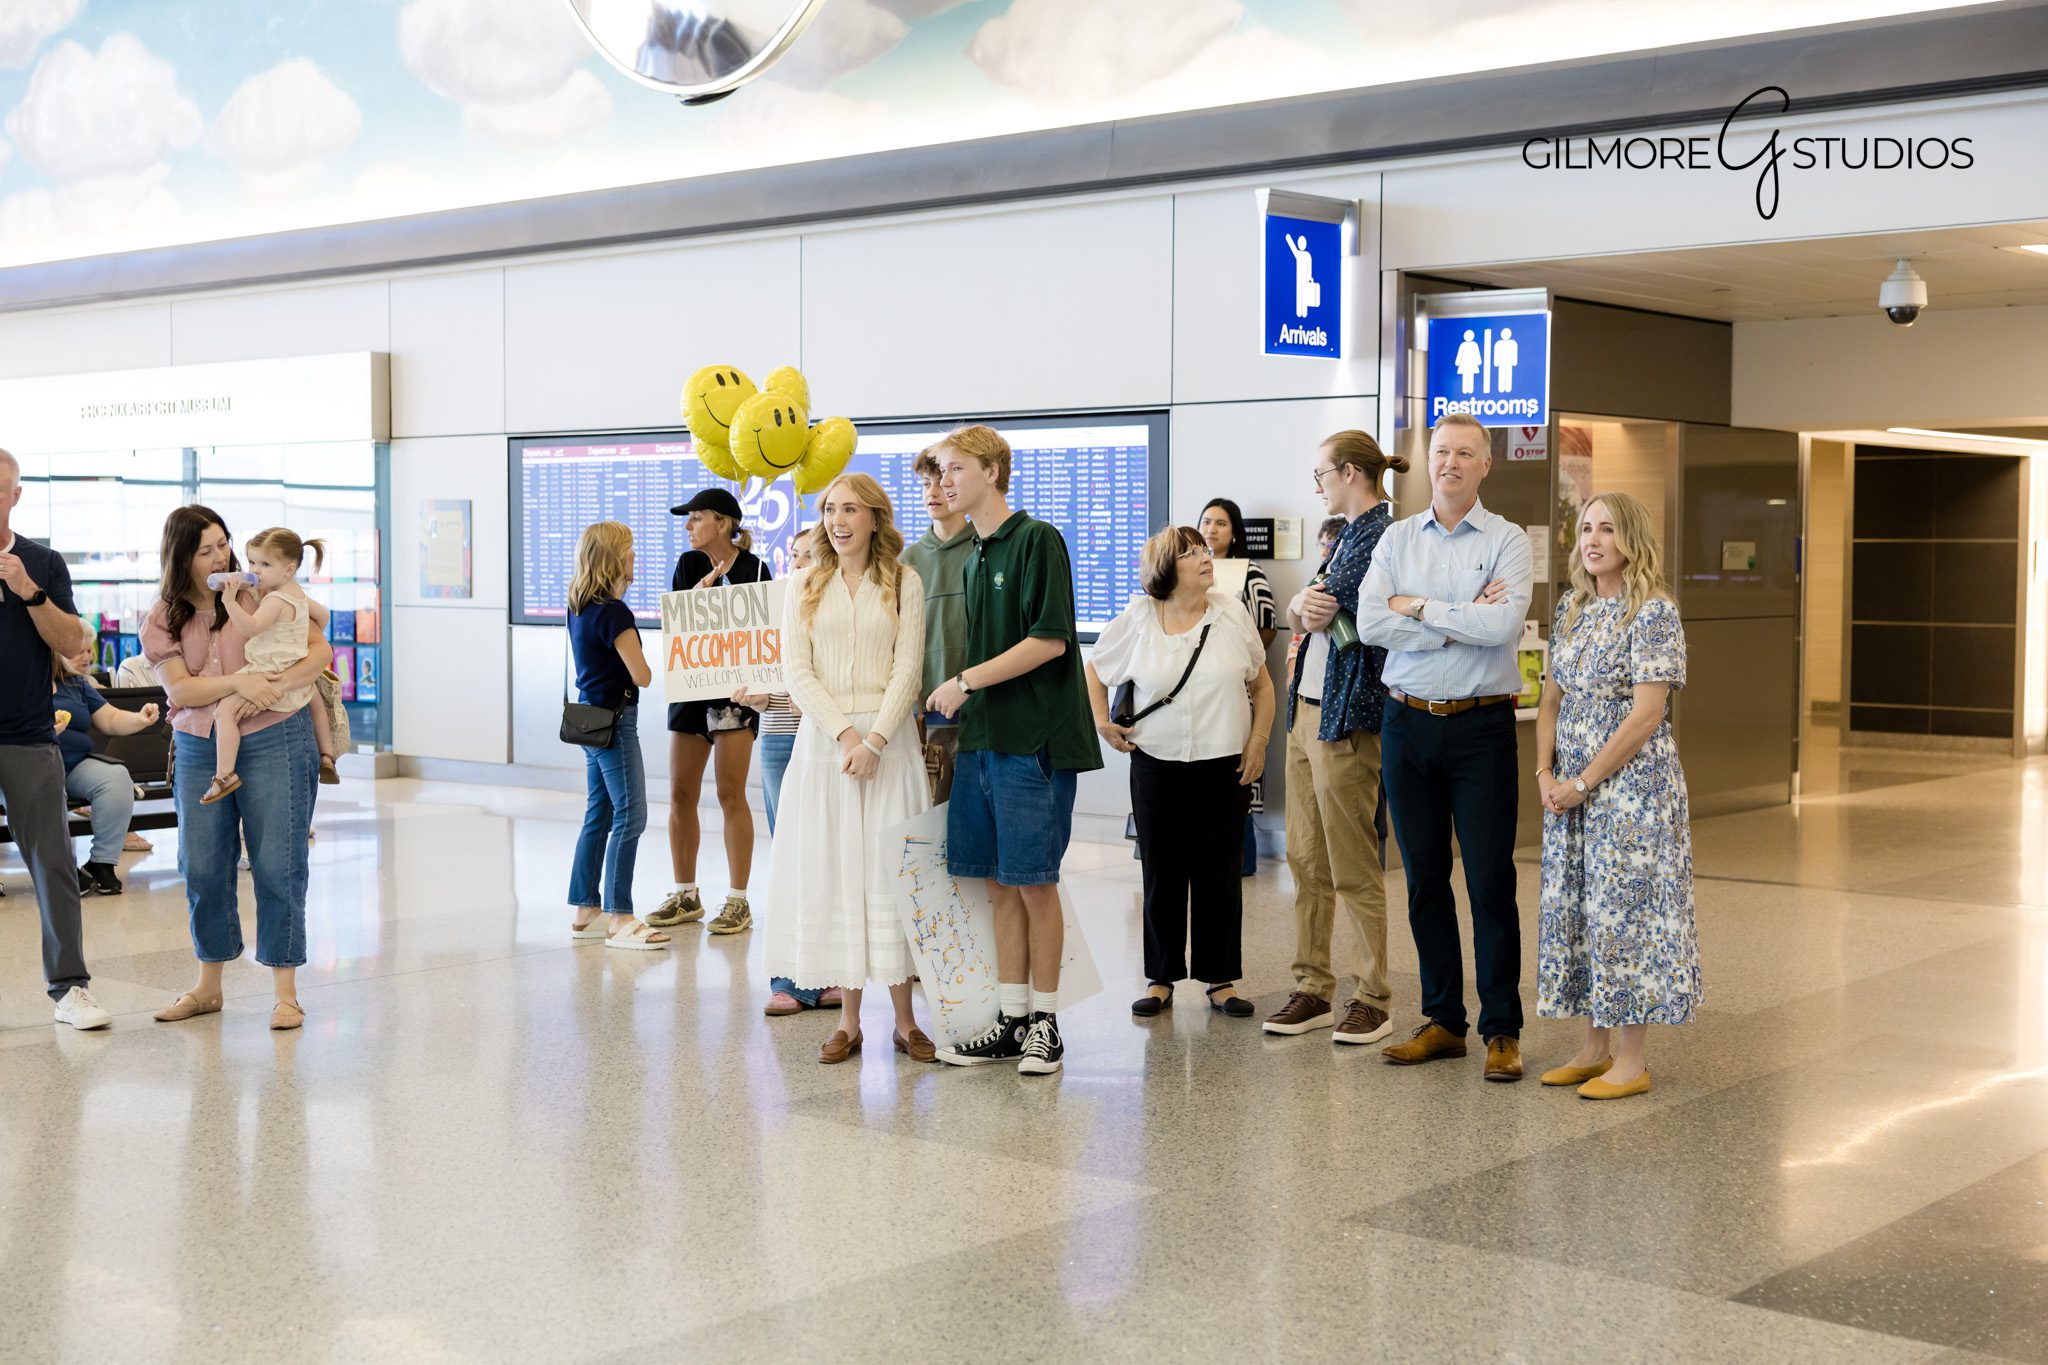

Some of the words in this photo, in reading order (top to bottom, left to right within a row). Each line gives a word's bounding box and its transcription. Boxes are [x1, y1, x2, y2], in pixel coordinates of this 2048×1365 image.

[1279, 323, 1328, 347] Arrivals
[1433, 396, 1539, 416] Restrooms
[1526, 447, 1546, 456] STOP
[662, 584, 770, 634] MISSION
[684, 668, 749, 689] WELCOME
[752, 666, 785, 684] HOME
